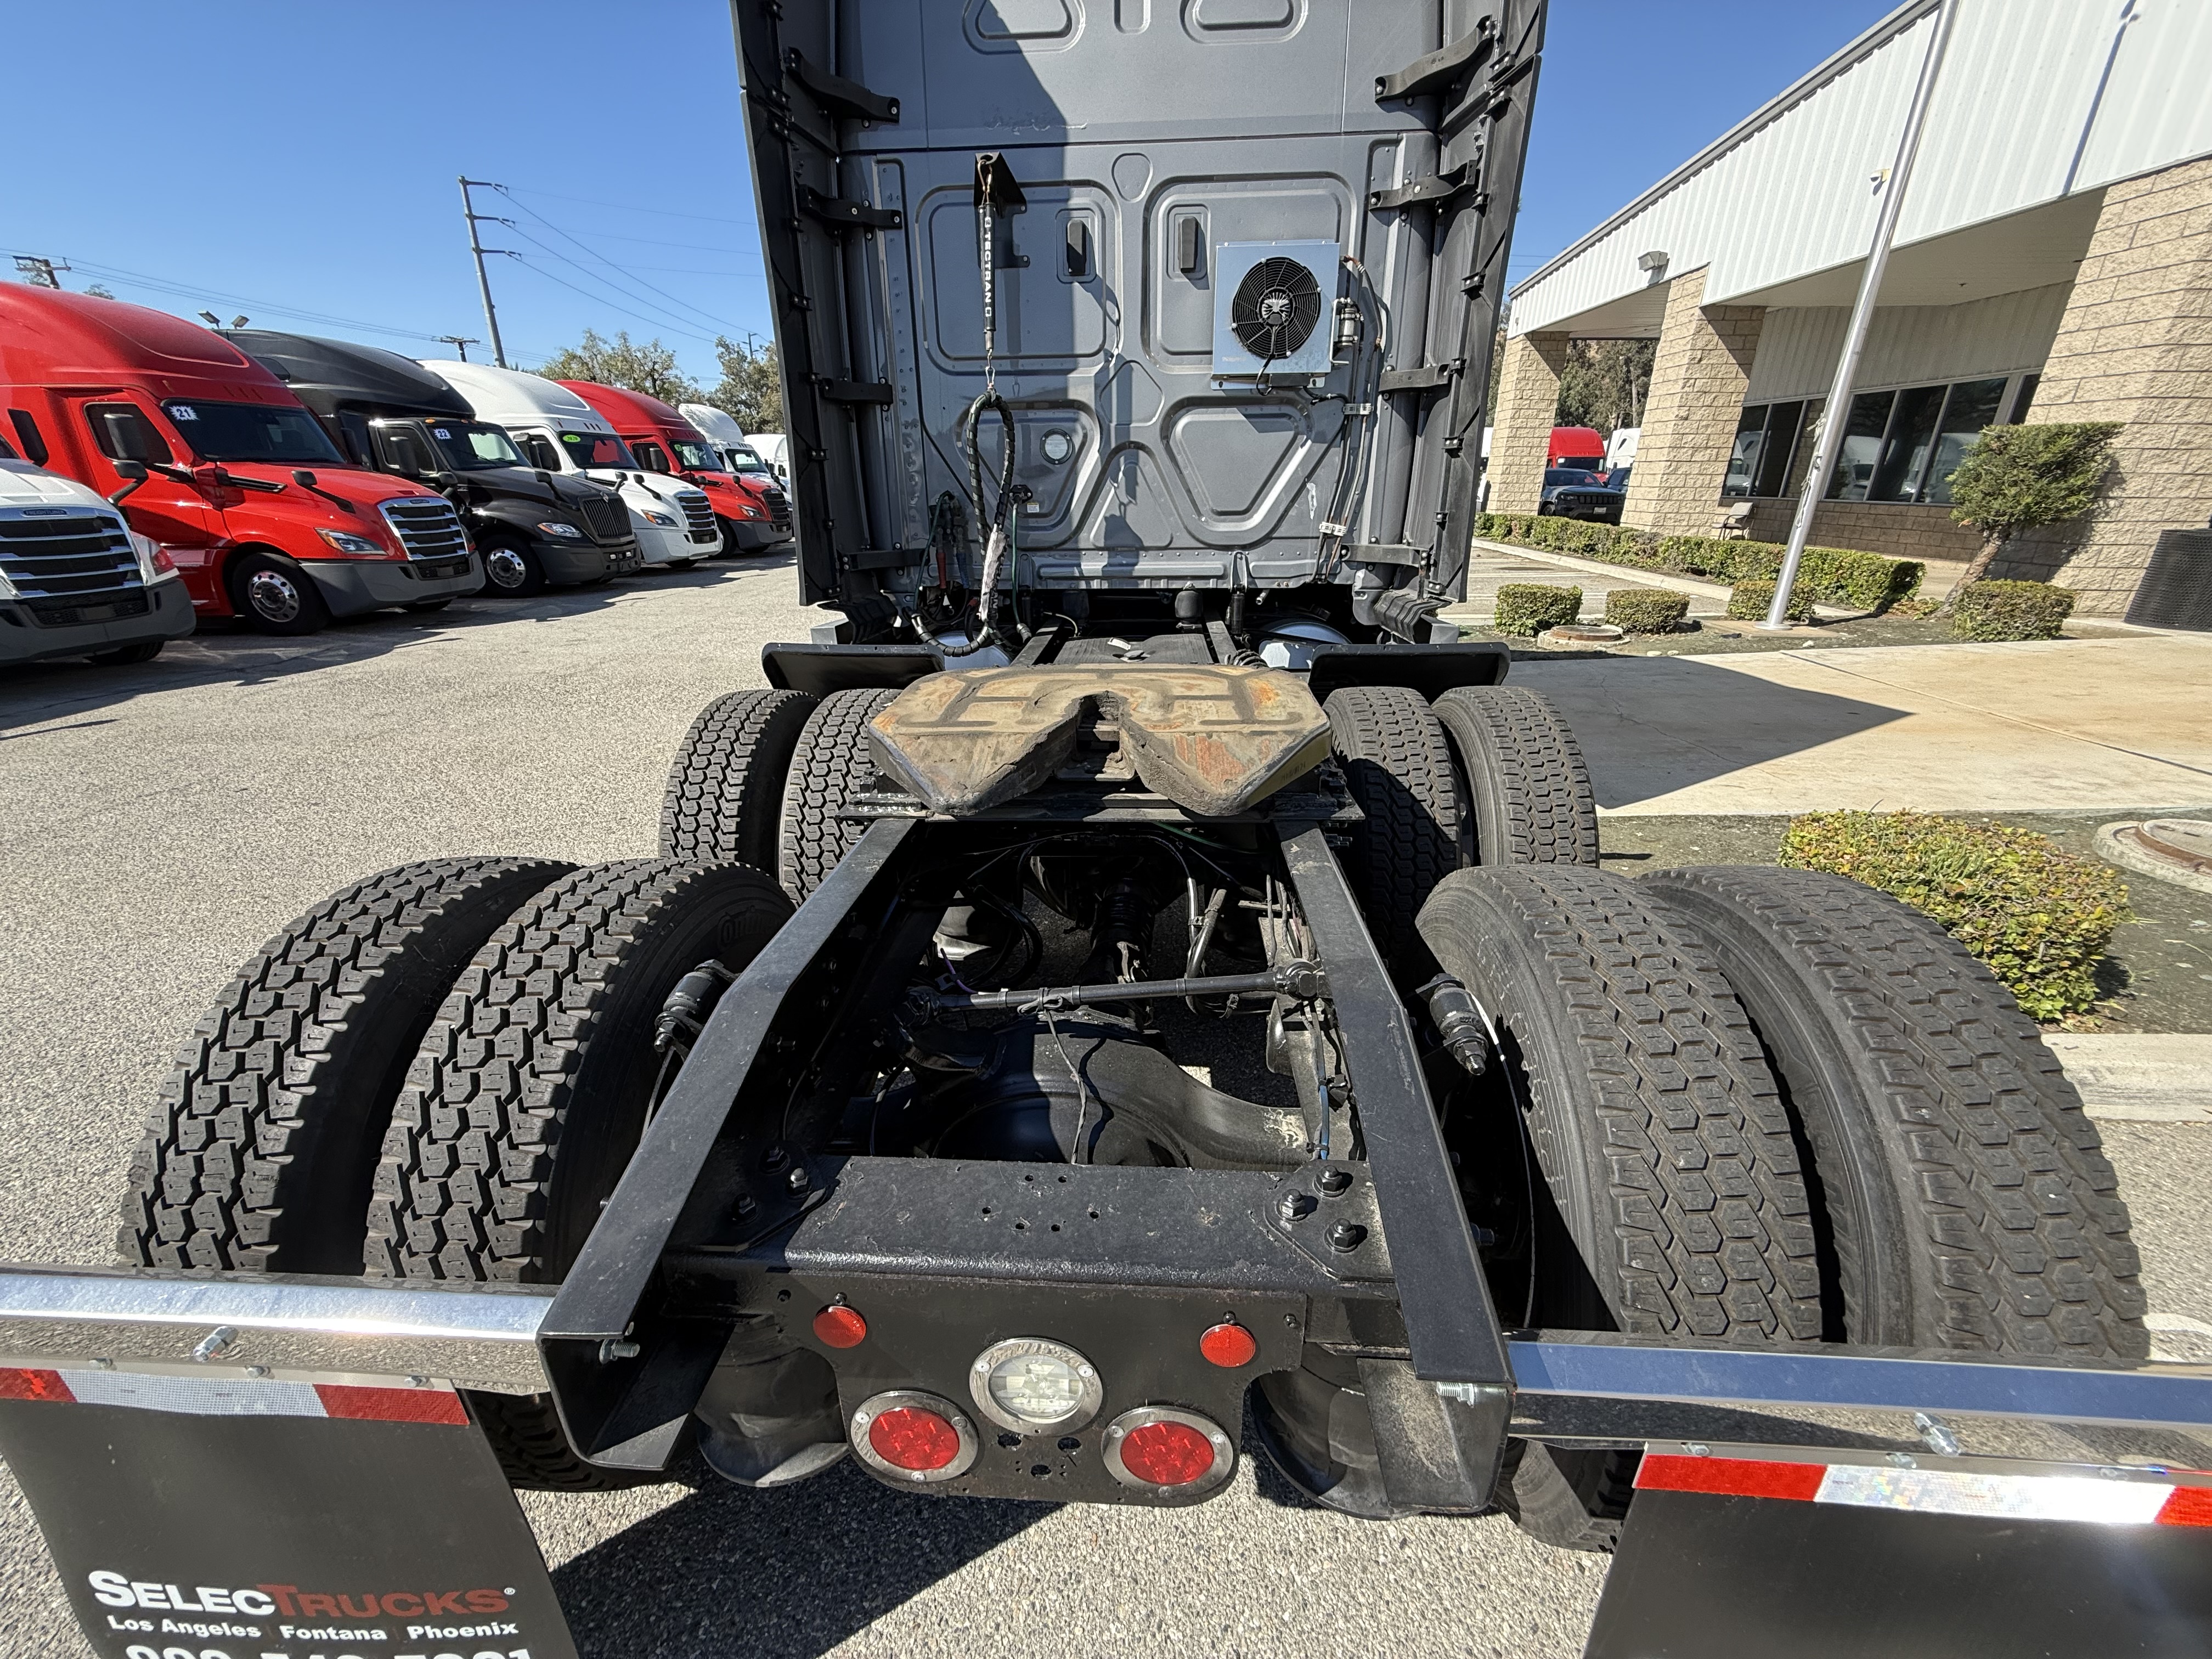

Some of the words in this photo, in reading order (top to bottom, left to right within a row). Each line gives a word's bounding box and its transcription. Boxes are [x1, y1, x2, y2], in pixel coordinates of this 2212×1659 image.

[176, 408, 191, 417] 21
[106, 1615, 155, 1632] Los
[161, 1618, 262, 1638] Angeles
[279, 1624, 388, 1641] Fontana
[406, 1622, 520, 1639] Phoenix
